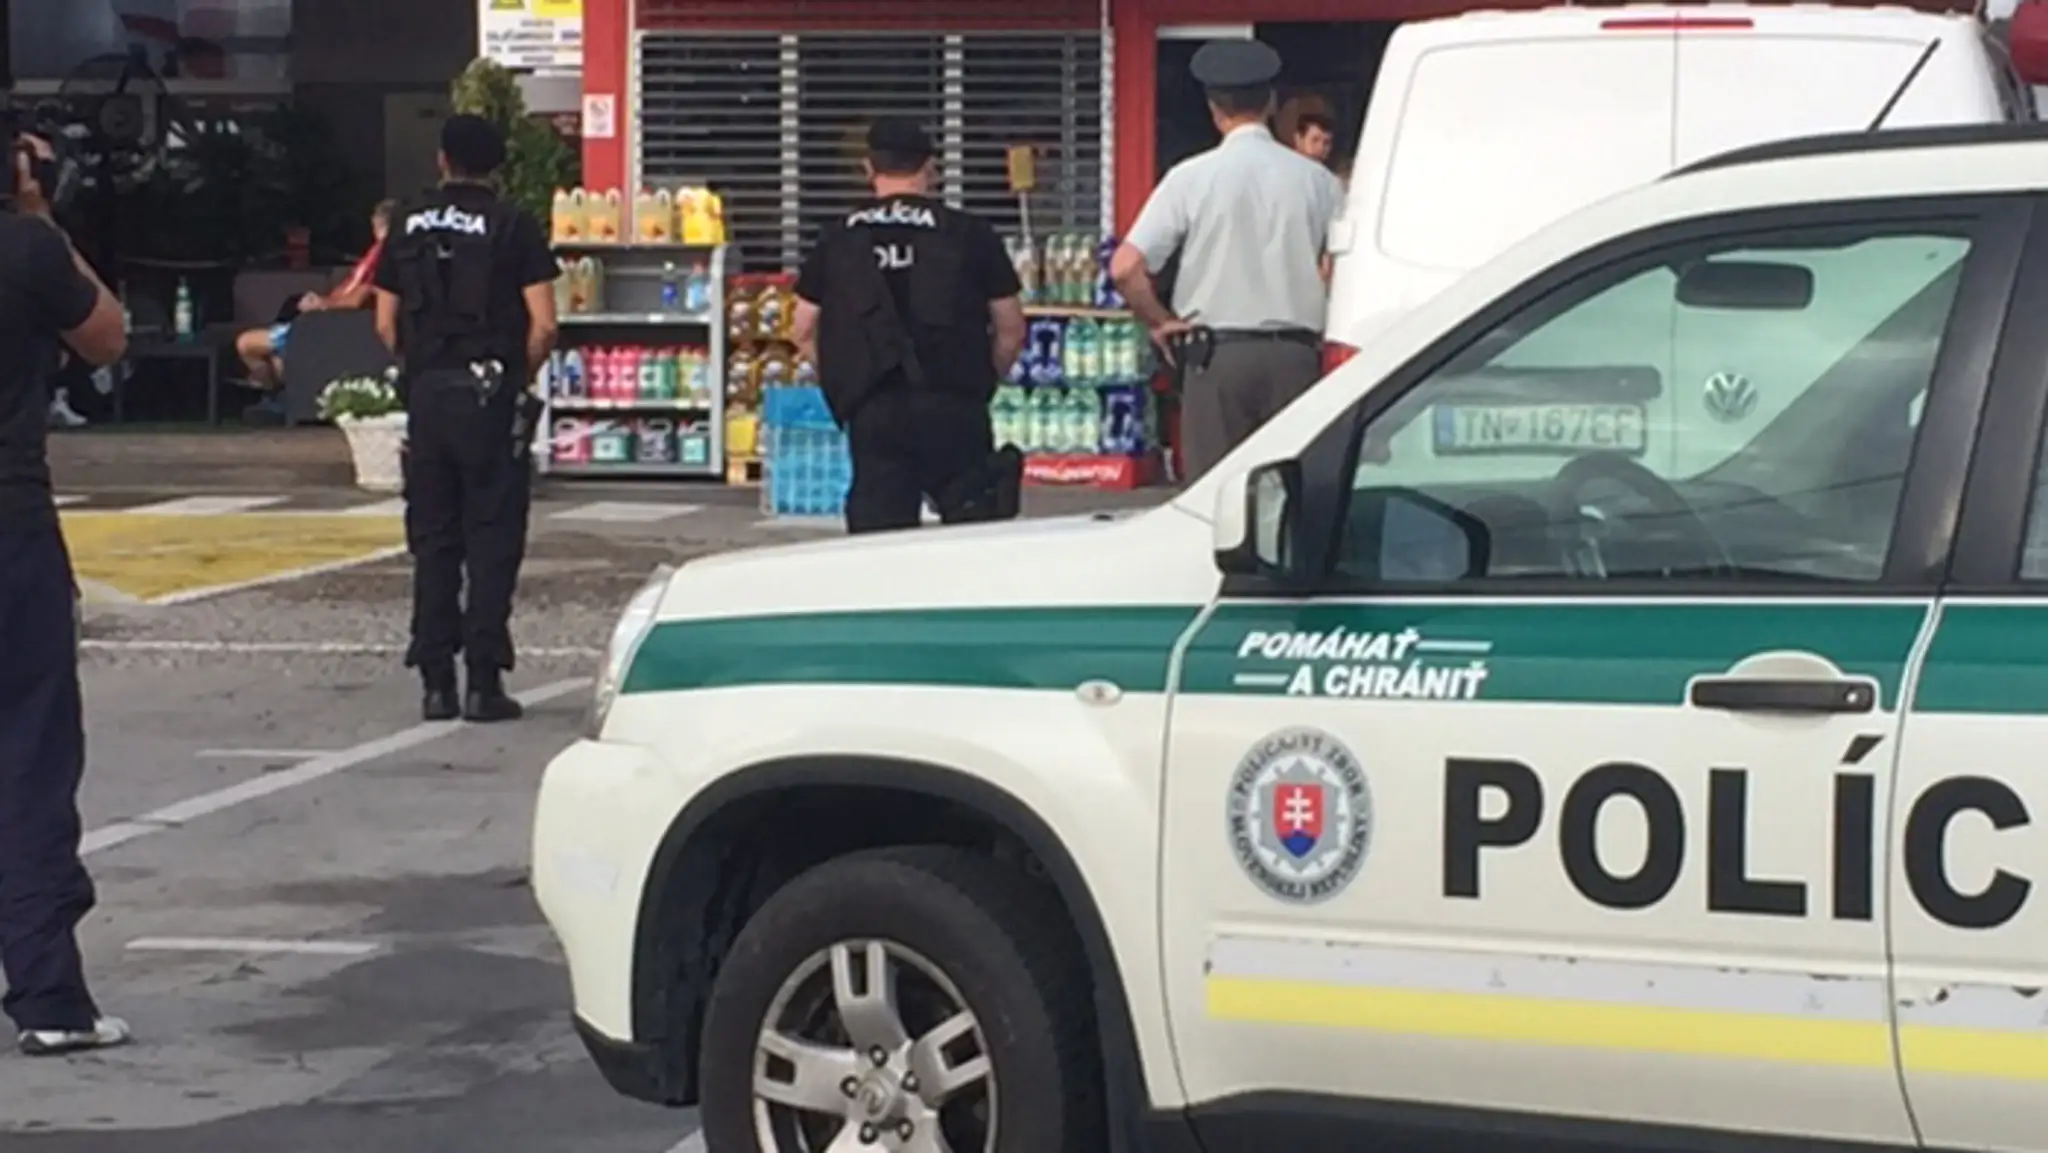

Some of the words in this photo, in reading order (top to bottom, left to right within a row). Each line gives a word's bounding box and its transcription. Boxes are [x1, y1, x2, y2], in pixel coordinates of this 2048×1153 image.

[1238, 625, 1420, 660] POMÁHAŤ
[1287, 663, 1314, 696] A
[1324, 658, 1489, 700] CHRÁNIŤ
[1442, 734, 2033, 929] POLÍC
